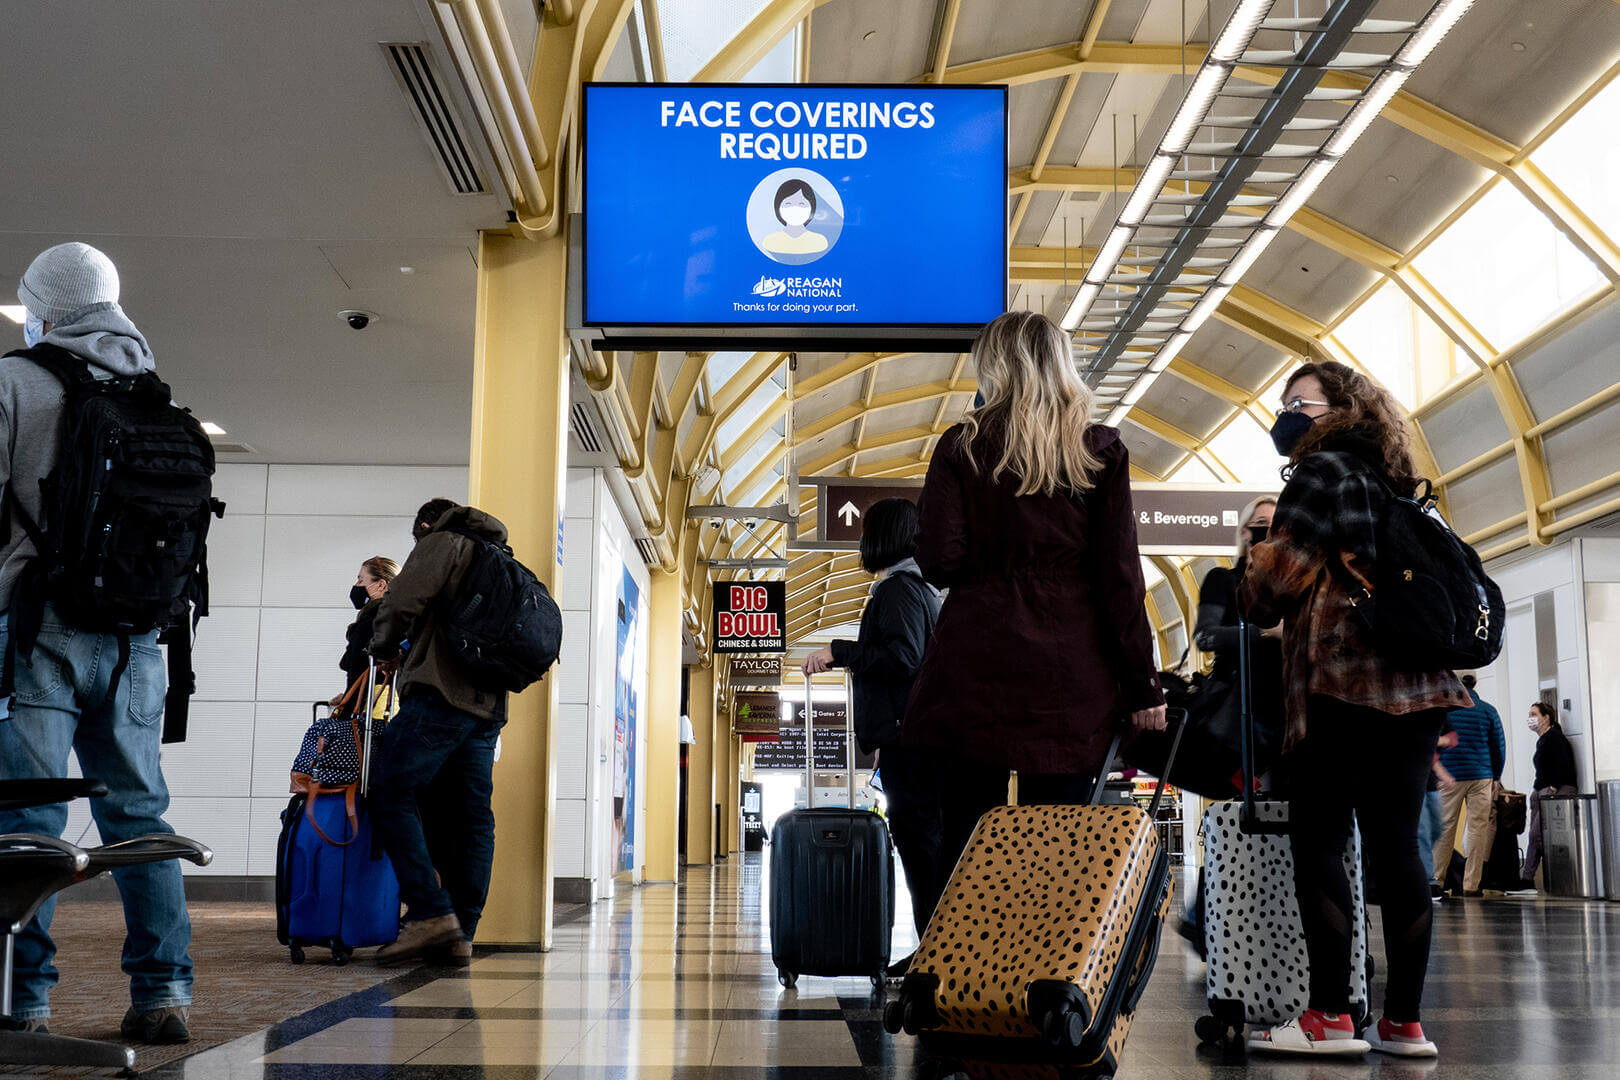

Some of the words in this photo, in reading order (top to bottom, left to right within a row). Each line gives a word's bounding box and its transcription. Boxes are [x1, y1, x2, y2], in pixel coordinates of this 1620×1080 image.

[661, 100, 741, 128] FACE
[749, 100, 936, 129] COVERINGS
[720, 132, 868, 161] REQUIRED
[786, 277, 842, 288] REAGAN
[786, 288, 842, 298] NATIONAL
[733, 302, 765, 312] Thanks
[767, 302, 780, 312] for
[782, 302, 811, 314] doing
[812, 304, 834, 313] your
[835, 302, 859, 314] part.
[1139, 511, 1151, 524] &
[1154, 511, 1219, 528] Beverage
[730, 586, 768, 611] BIG
[718, 611, 781, 638] BOWL
[718, 639, 751, 648] CHINESE
[750, 640, 758, 648] &
[758, 639, 782, 648] SUSHI
[733, 660, 780, 669] TAYLOR
